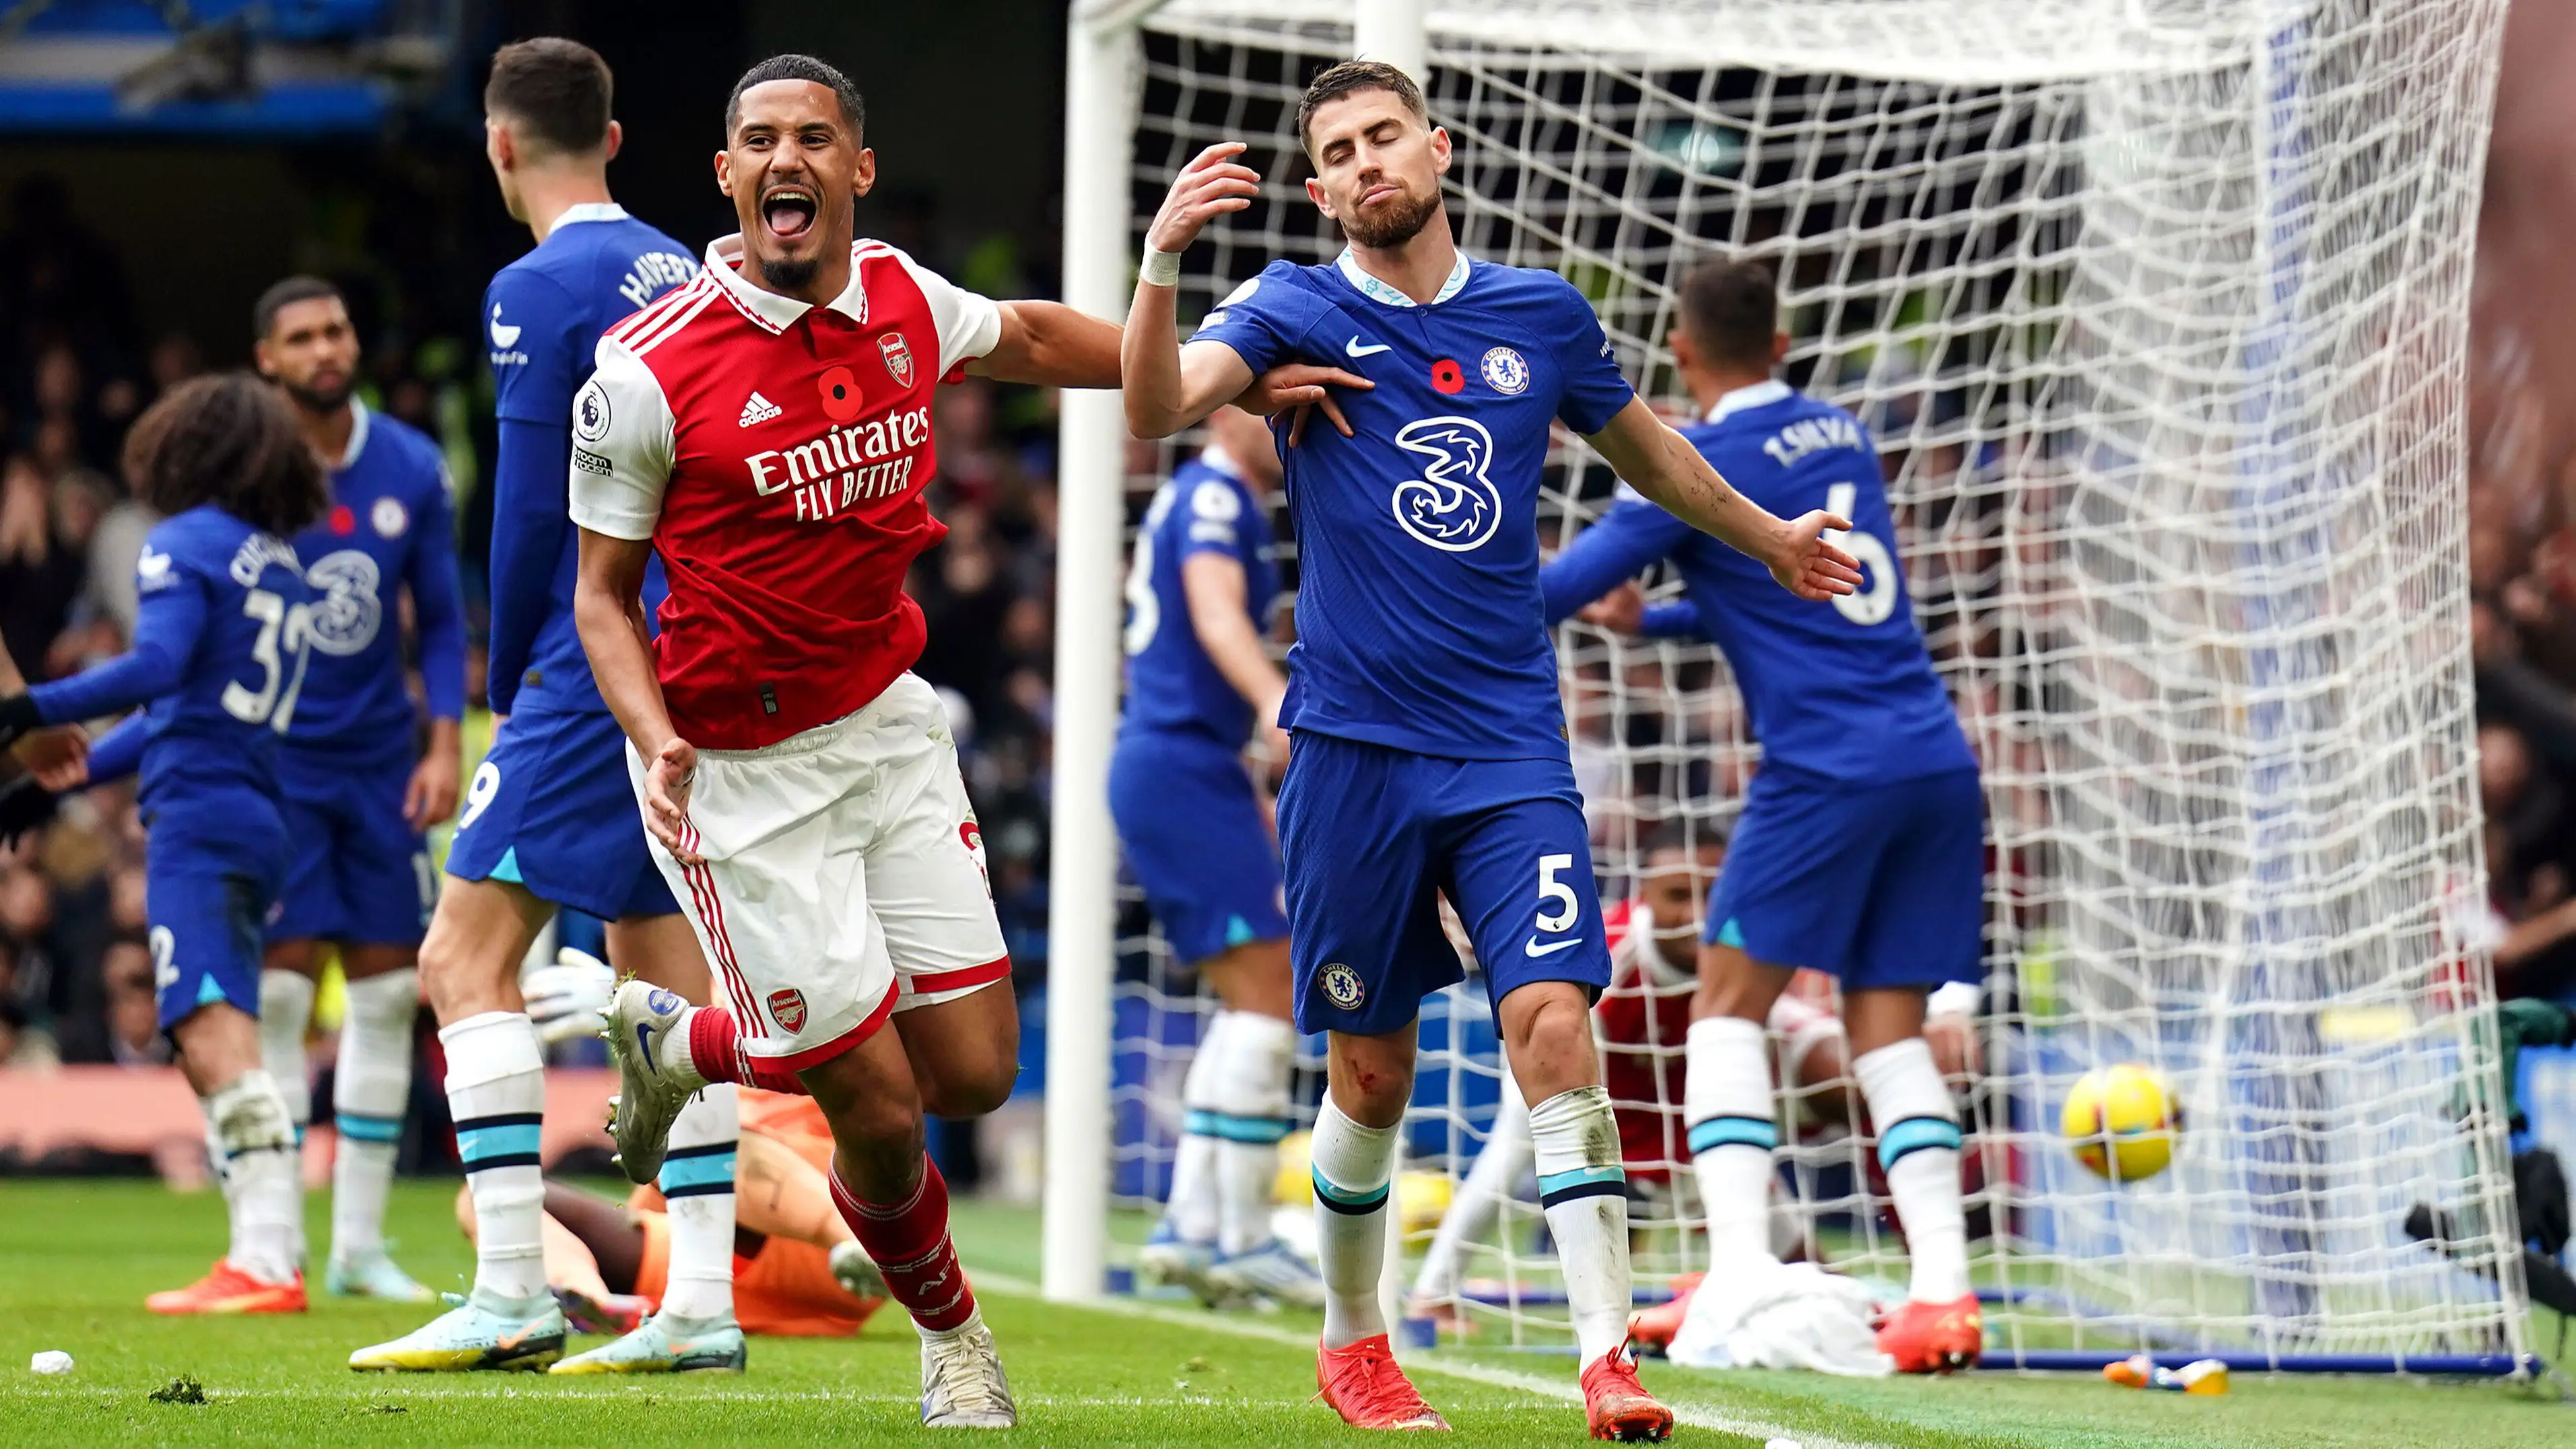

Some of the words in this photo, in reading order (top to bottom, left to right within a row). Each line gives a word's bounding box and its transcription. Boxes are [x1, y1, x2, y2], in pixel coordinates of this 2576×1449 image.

[619, 251, 698, 309] HAVERT
[883, 339, 904, 353] Arsenal
[1486, 349, 1516, 362] CHELSEA
[739, 405, 783, 428] adidas
[576, 459, 614, 478] racism
[577, 449, 607, 467] room
[744, 406, 929, 497] Emirates
[794, 479, 834, 522] FLY
[841, 455, 913, 509] BETTER
[1392, 415, 1502, 552] 3
[1823, 482, 1898, 626] 6
[459, 761, 500, 830] 9
[1535, 853, 1579, 933] 5
[149, 924, 180, 988] 2
[1324, 965, 1353, 976] CHELSEA
[772, 994, 799, 1008] Arsenal
